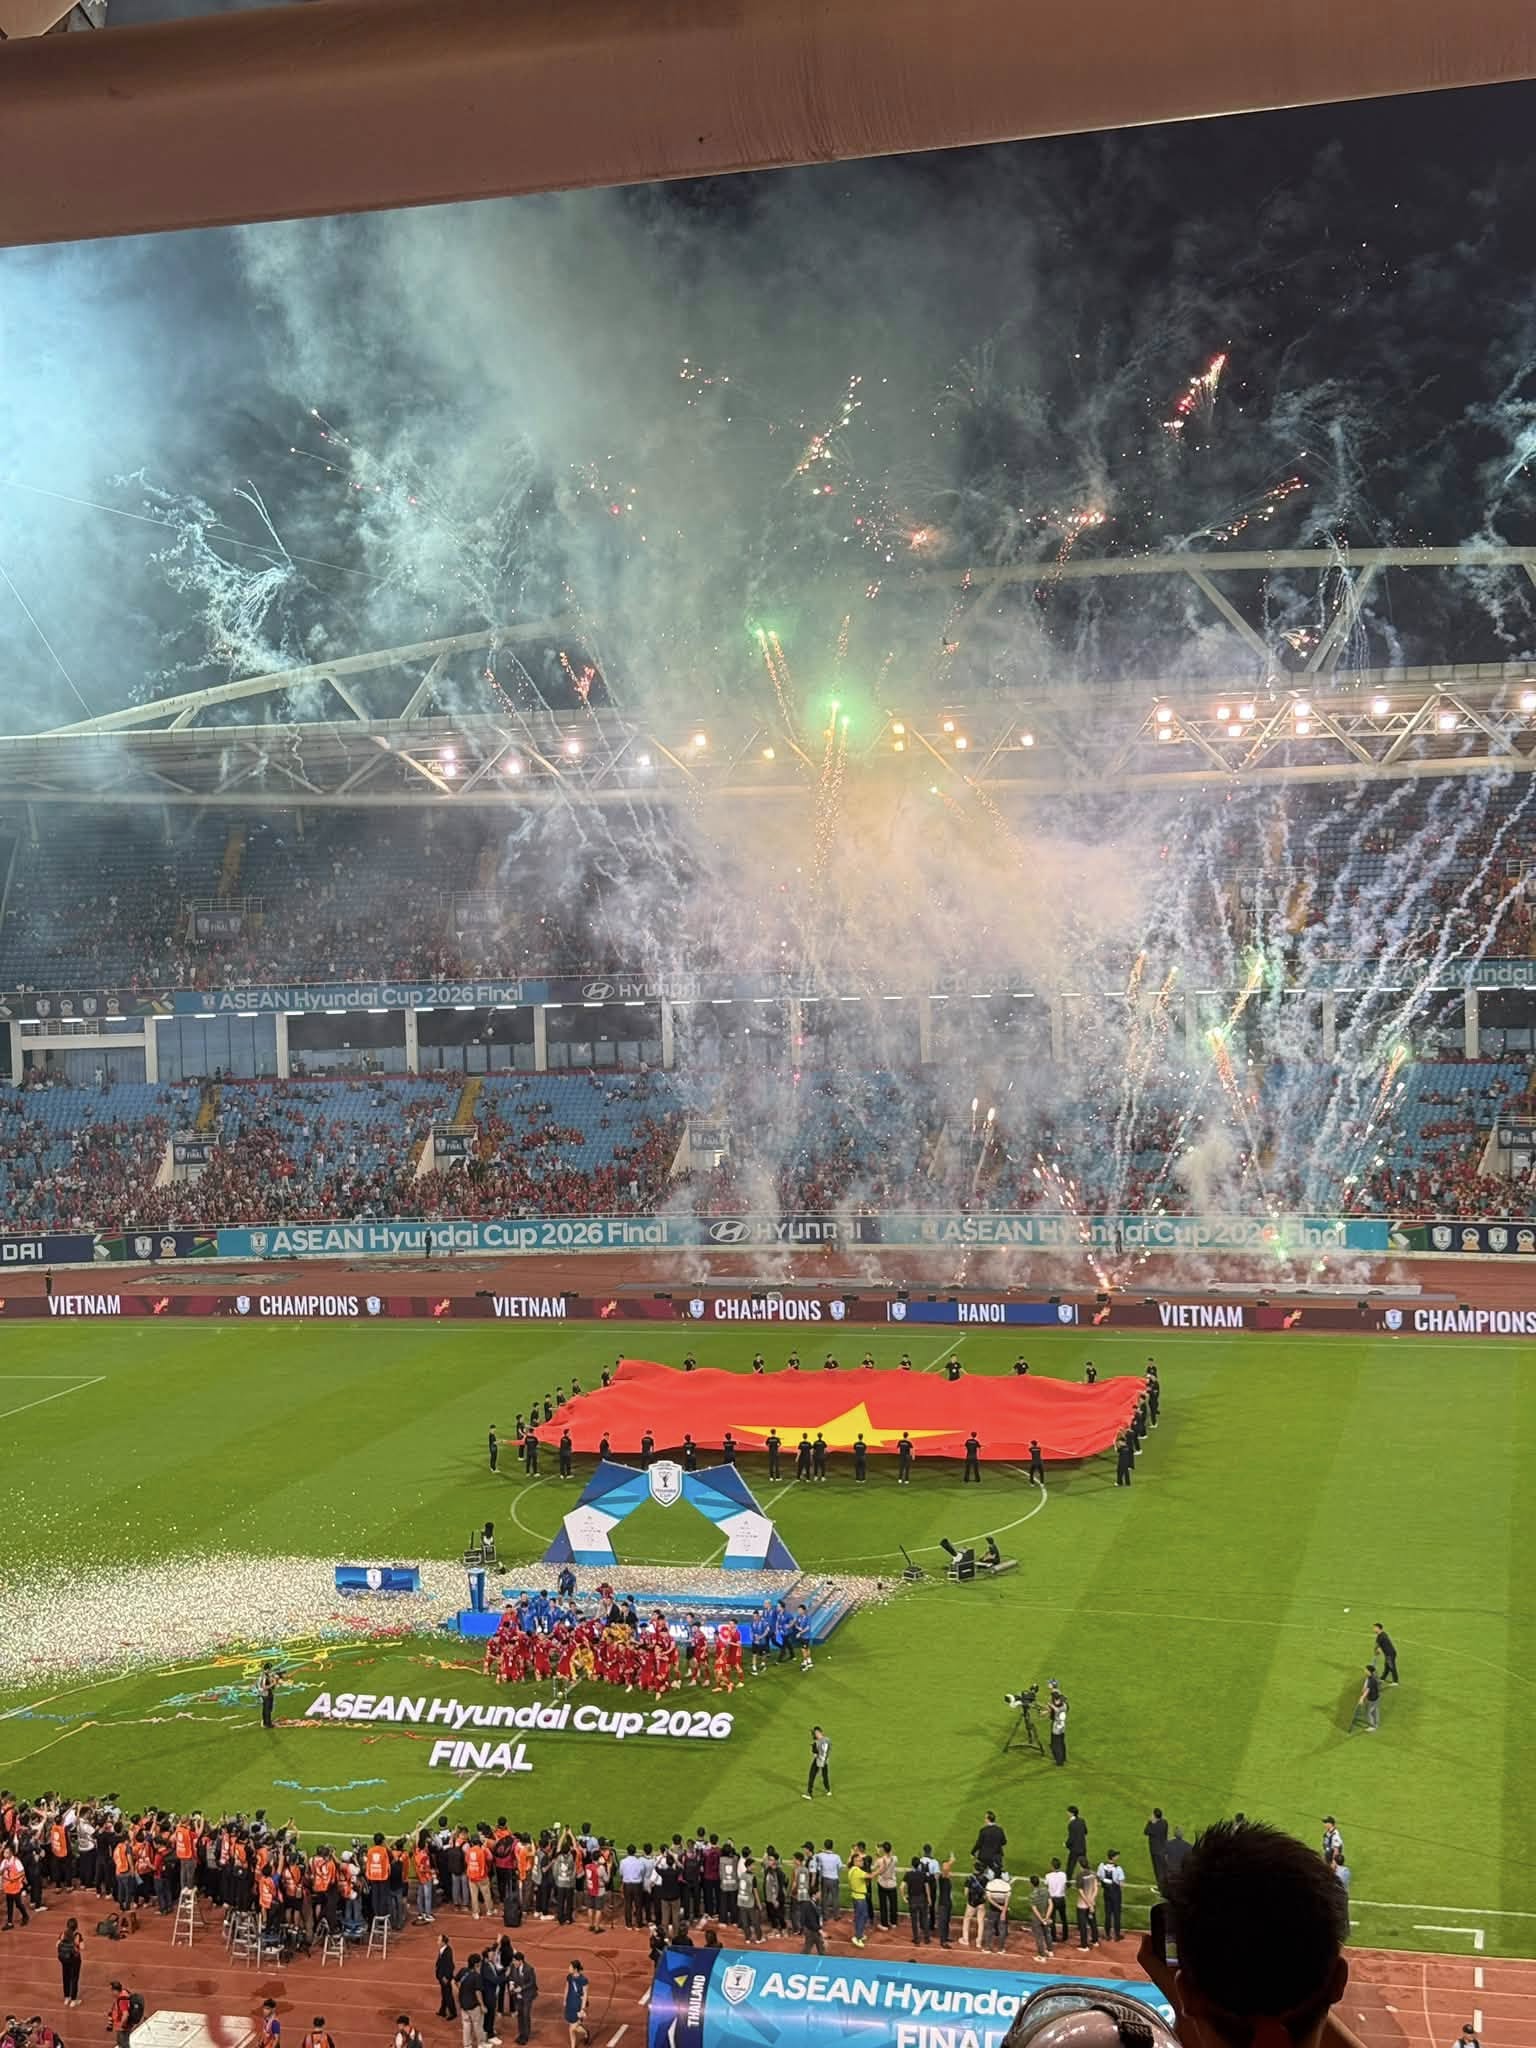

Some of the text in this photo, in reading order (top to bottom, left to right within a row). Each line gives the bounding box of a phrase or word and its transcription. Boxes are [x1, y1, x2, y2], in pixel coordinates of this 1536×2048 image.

[219, 991, 290, 1009] ASEAN
[294, 987, 378, 1010] Hyundai
[382, 988, 424, 1007] Cup
[428, 986, 474, 1003] 2026
[272, 1228, 364, 1252] ASEAN
[369, 1223, 479, 1252] Hyundai
[484, 1224, 538, 1249] Cup
[542, 1223, 603, 1245] 2026
[941, 1219, 1033, 1242] ASEAN
[1039, 1218, 1150, 1247] Hndai
[1153, 1220, 1210, 1248] Cup
[48, 1295, 121, 1315] VIETNAM
[260, 1296, 359, 1316] CHAMPIONS
[492, 1297, 566, 1318] VIETNAM
[714, 1299, 822, 1321] CHAMPIONS
[958, 1303, 1005, 1323] HANOI
[1159, 1305, 1243, 1328] VIETNAM
[1414, 1309, 1536, 1334] CHAMPIONS
[305, 1692, 735, 1739] ASEAN Hyundai Cup 2026
[428, 1740, 534, 1771] FINAL
[687, 1974, 706, 2028] THAILAND
[760, 1972, 879, 2007] ASEAN
